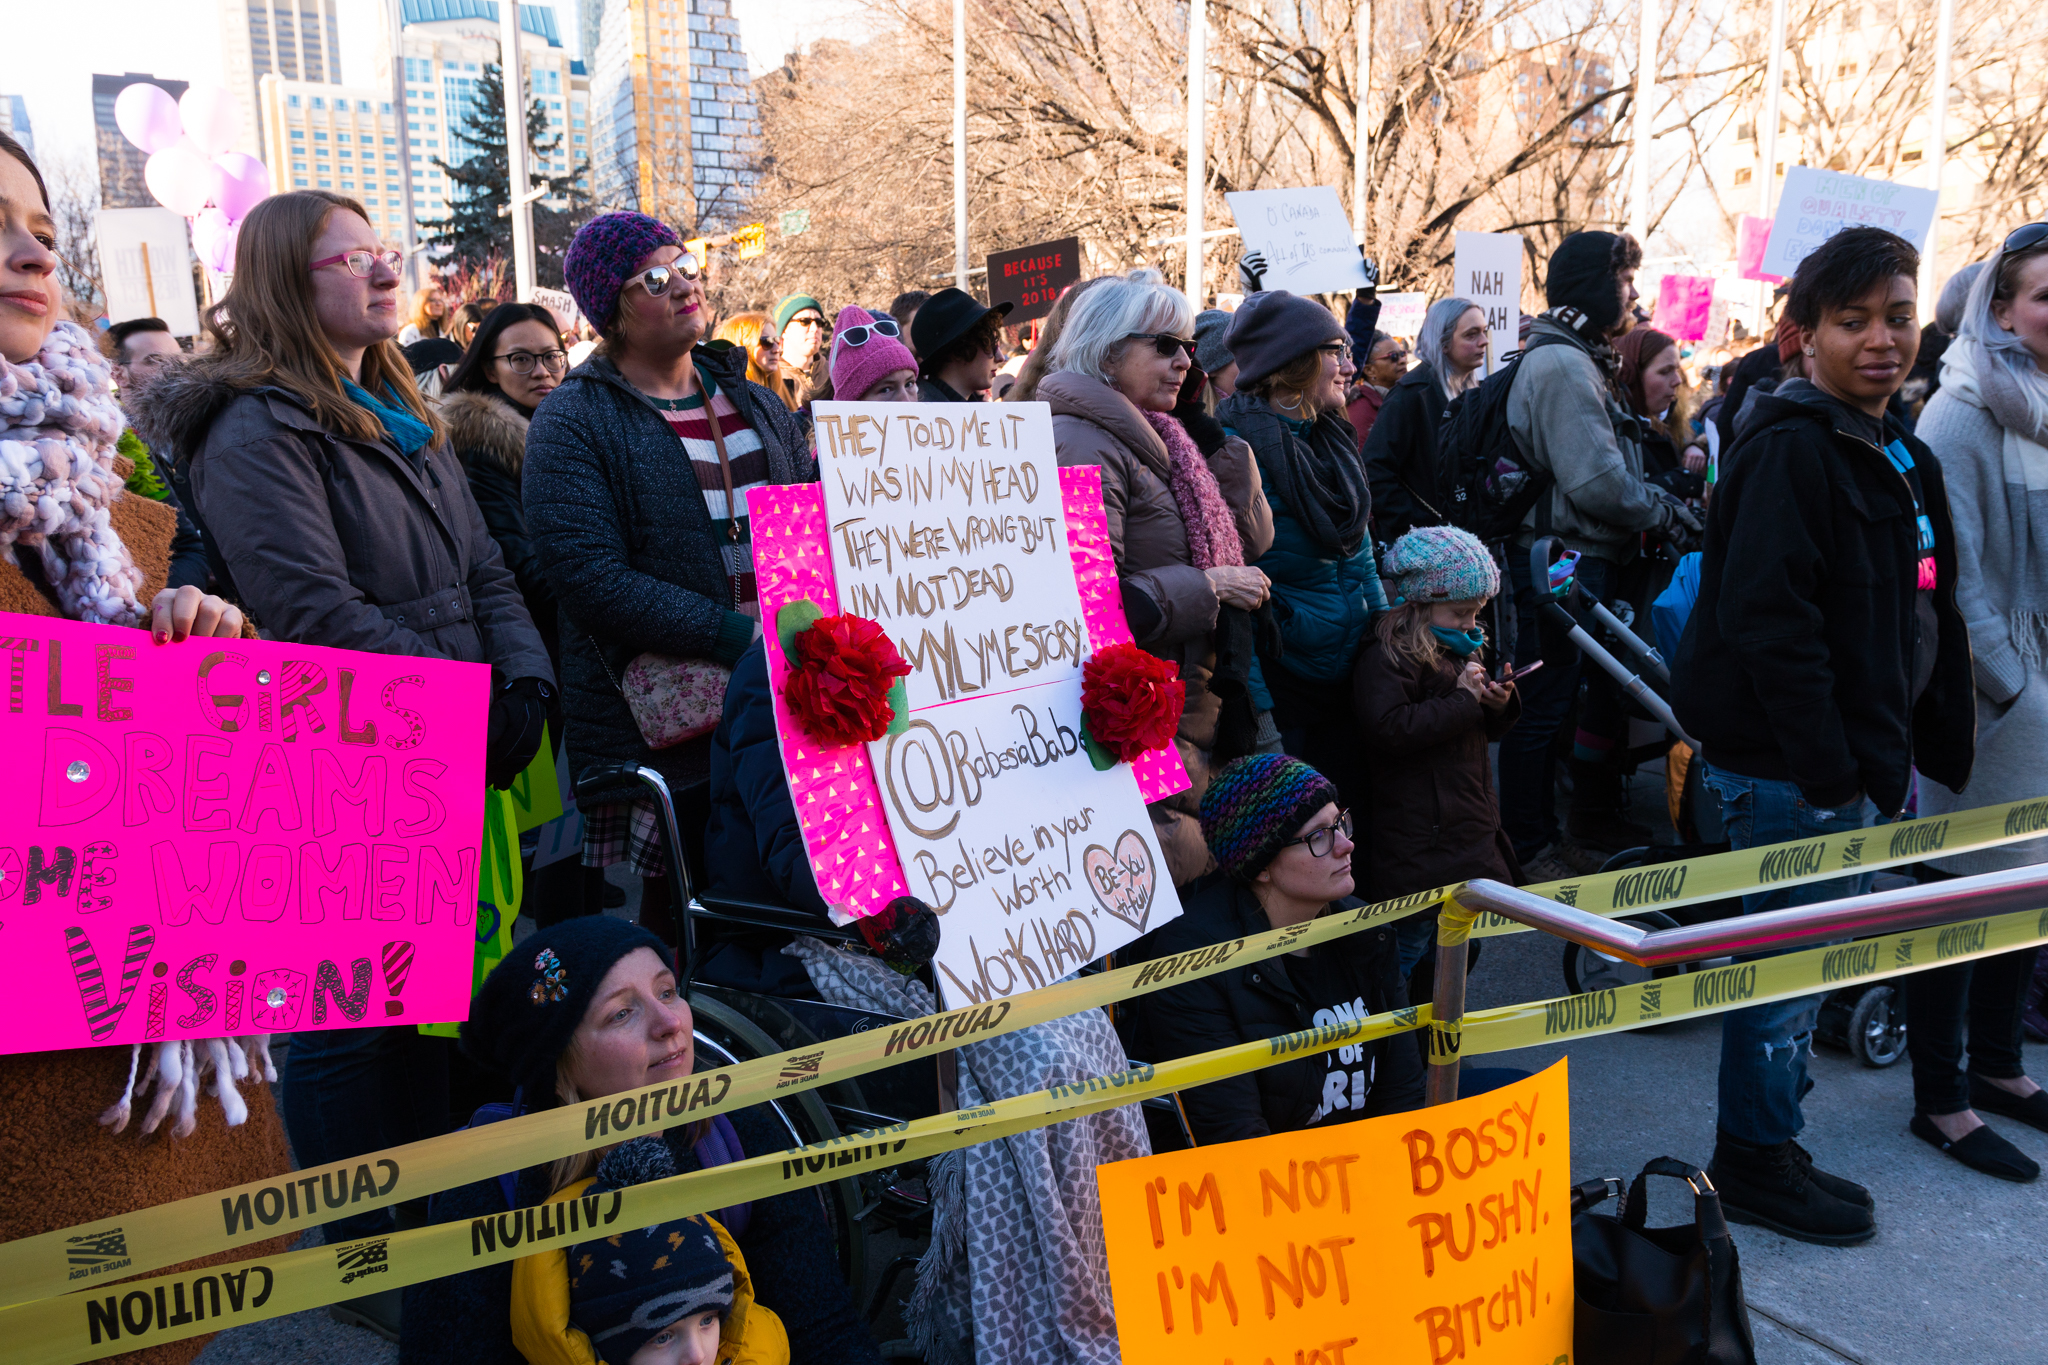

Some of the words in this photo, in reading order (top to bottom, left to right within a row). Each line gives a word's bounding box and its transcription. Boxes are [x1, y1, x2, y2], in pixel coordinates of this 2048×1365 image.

[1800, 196, 1906, 227] QUALITY
[1815, 175, 1868, 200] MEN
[1871, 184, 1900, 205] OF
[1797, 216, 1847, 238] DON'
[1004, 253, 1062, 278] BECAUSE
[1023, 273, 1048, 288] IT'S
[1471, 270, 1504, 296] NAH
[531, 290, 572, 313] SMASH
[1022, 287, 1057, 307] 2018
[1482, 306, 1508, 331] AH
[815, 413, 889, 467] THEY
[897, 414, 955, 451] TOLD
[960, 410, 992, 453] ME
[1000, 413, 1026, 451] IT
[836, 462, 902, 509] WAS
[903, 456, 932, 506] IN
[939, 456, 976, 508] MY
[980, 460, 1039, 504] HEAD
[1455, 492, 1468, 502] 32
[832, 516, 893, 577] THEY
[891, 519, 951, 559] WERE
[945, 514, 1019, 557] WRONG
[1018, 514, 1058, 555] BUT
[849, 582, 892, 620] I'M
[897, 572, 949, 620] NOT
[947, 562, 1015, 611] DEAD
[38, 726, 449, 838] DREAMS
[151, 839, 477, 926] WOMEN
[913, 833, 1036, 917] Believe
[1031, 823, 1055, 852] in
[1051, 806, 1095, 875] your
[1031, 907, 1097, 984] HARD
[1144, 1172, 1227, 1249] I'M
[1259, 1153, 1361, 1217] NOT
[1400, 1091, 1546, 1197] BOSSY.
[1157, 1260, 1239, 1335] I'M
[1256, 1236, 1356, 1321] NOT
[1406, 1168, 1550, 1278] PUSHY.
[86, 1265, 274, 1345] CAUTION
[1413, 1256, 1551, 1365] BITCHY.
